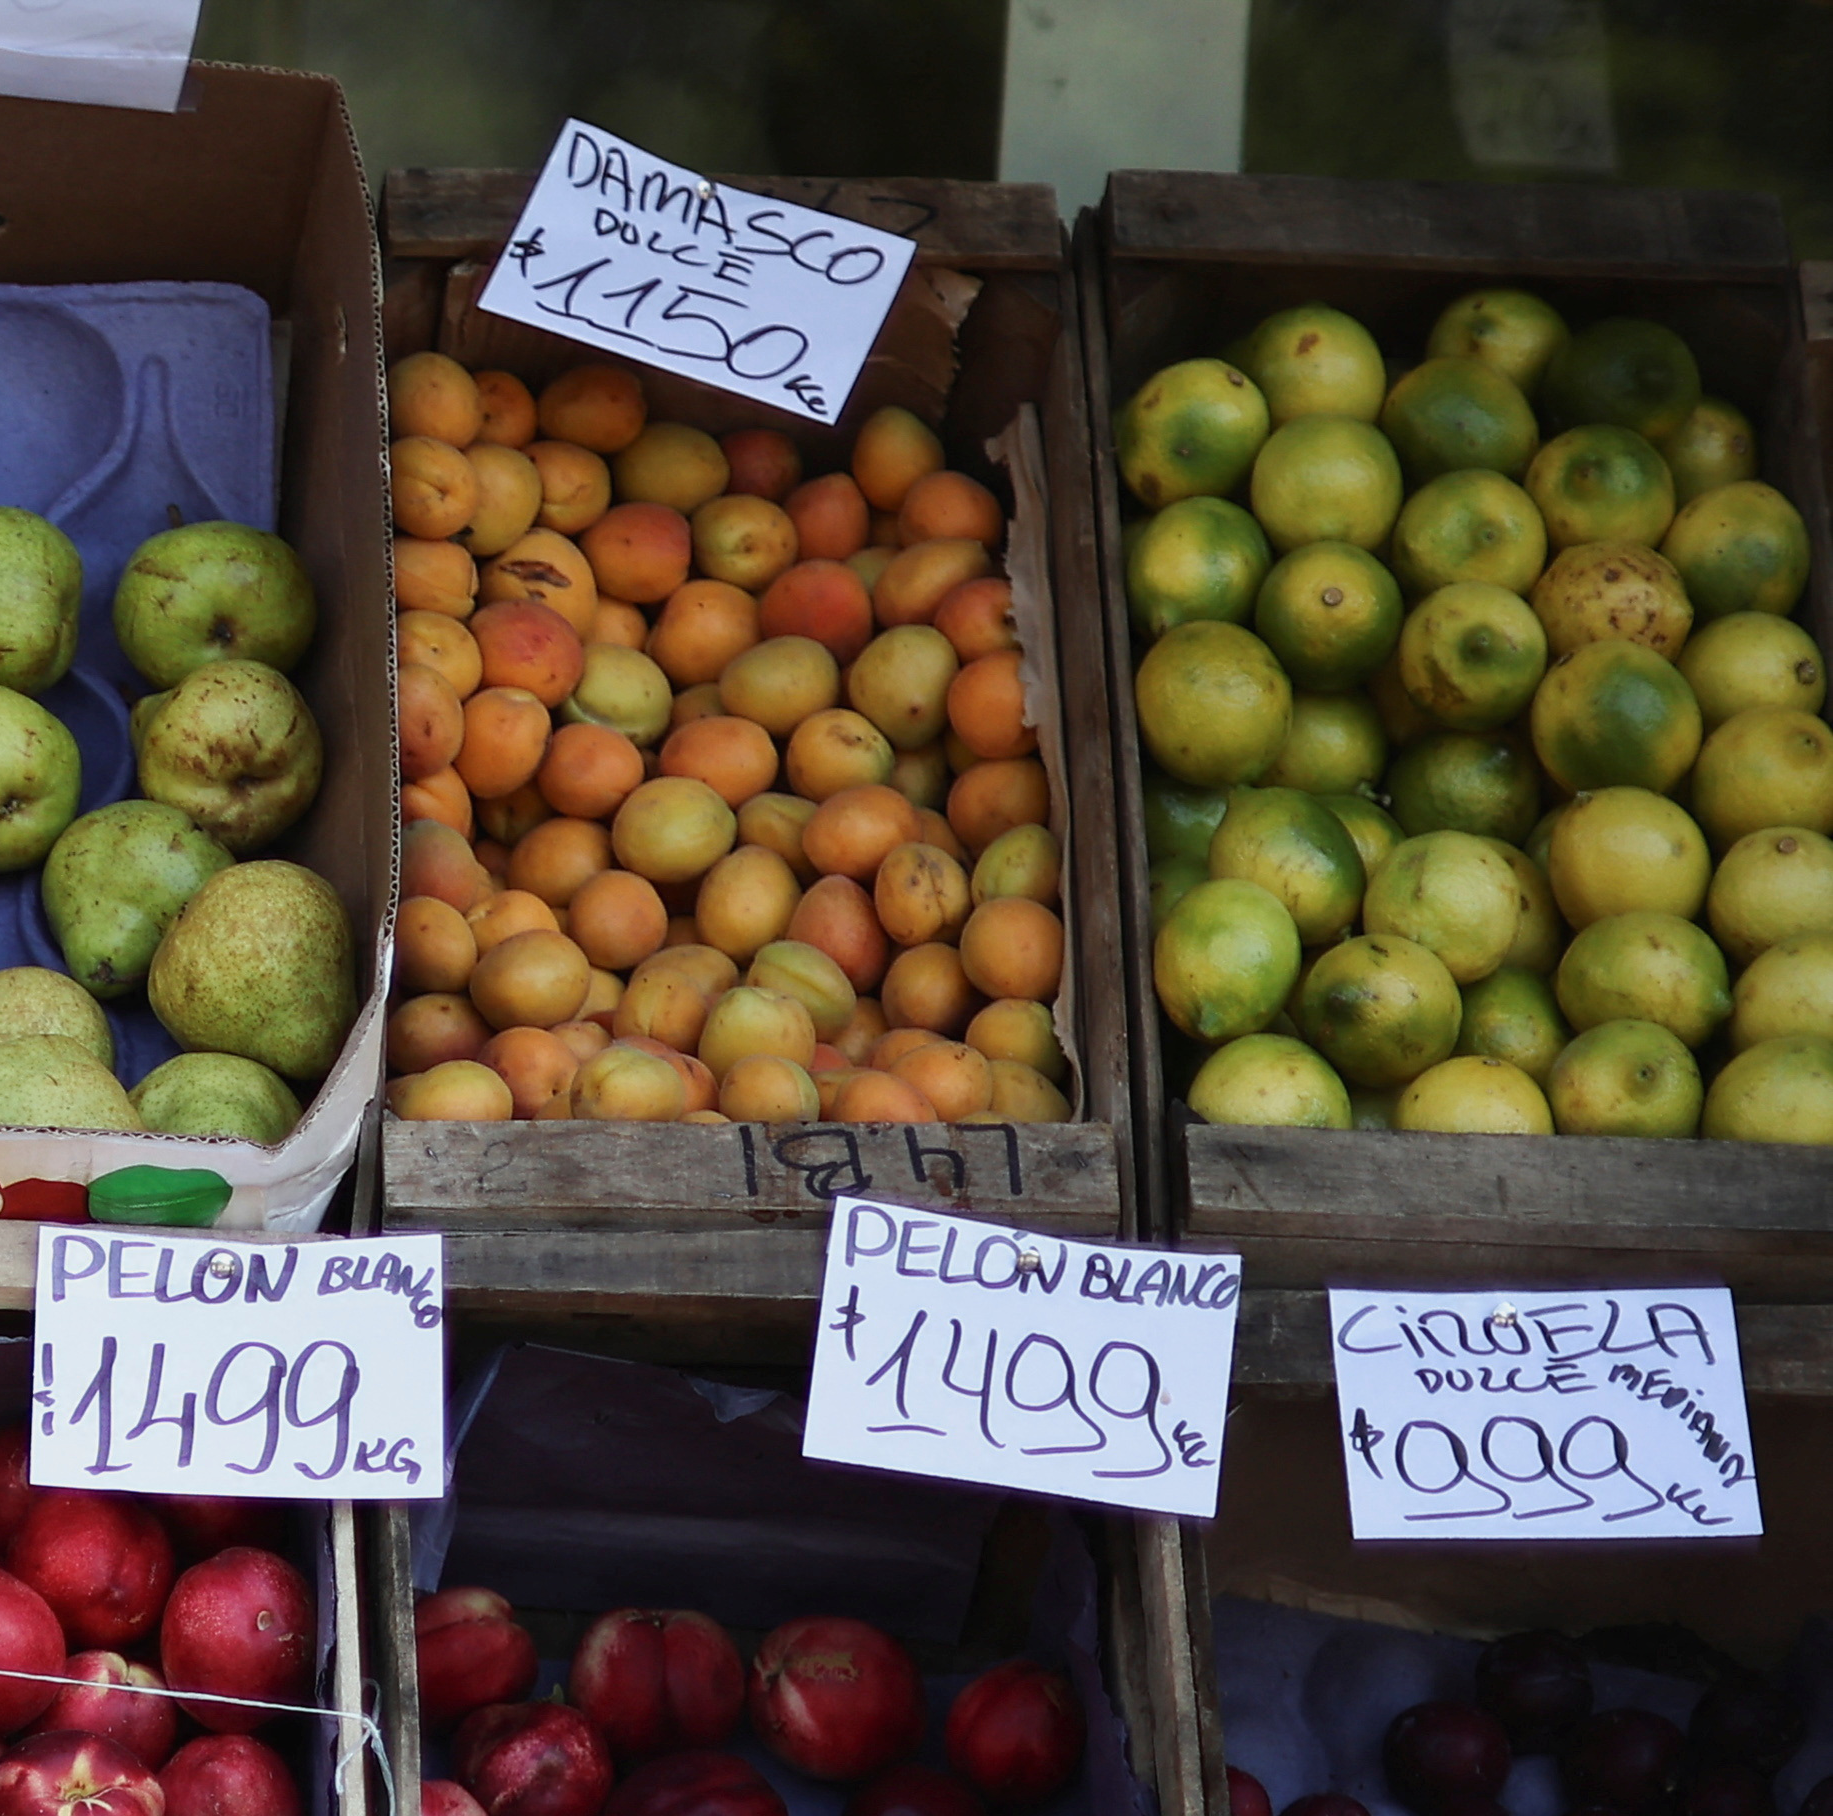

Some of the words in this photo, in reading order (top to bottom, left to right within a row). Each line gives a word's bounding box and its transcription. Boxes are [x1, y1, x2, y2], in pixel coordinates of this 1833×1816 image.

[567, 130, 885, 285] DAMASCO
[509, 226, 809, 380] $1150
[52, 1234, 298, 1304] PELON
[845, 1205, 1068, 1295] PELÓN
[1080, 1252, 1241, 1309] BLANCO
[1414, 1362, 1599, 1394] DULCE
[353, 1437, 422, 1485] KG
